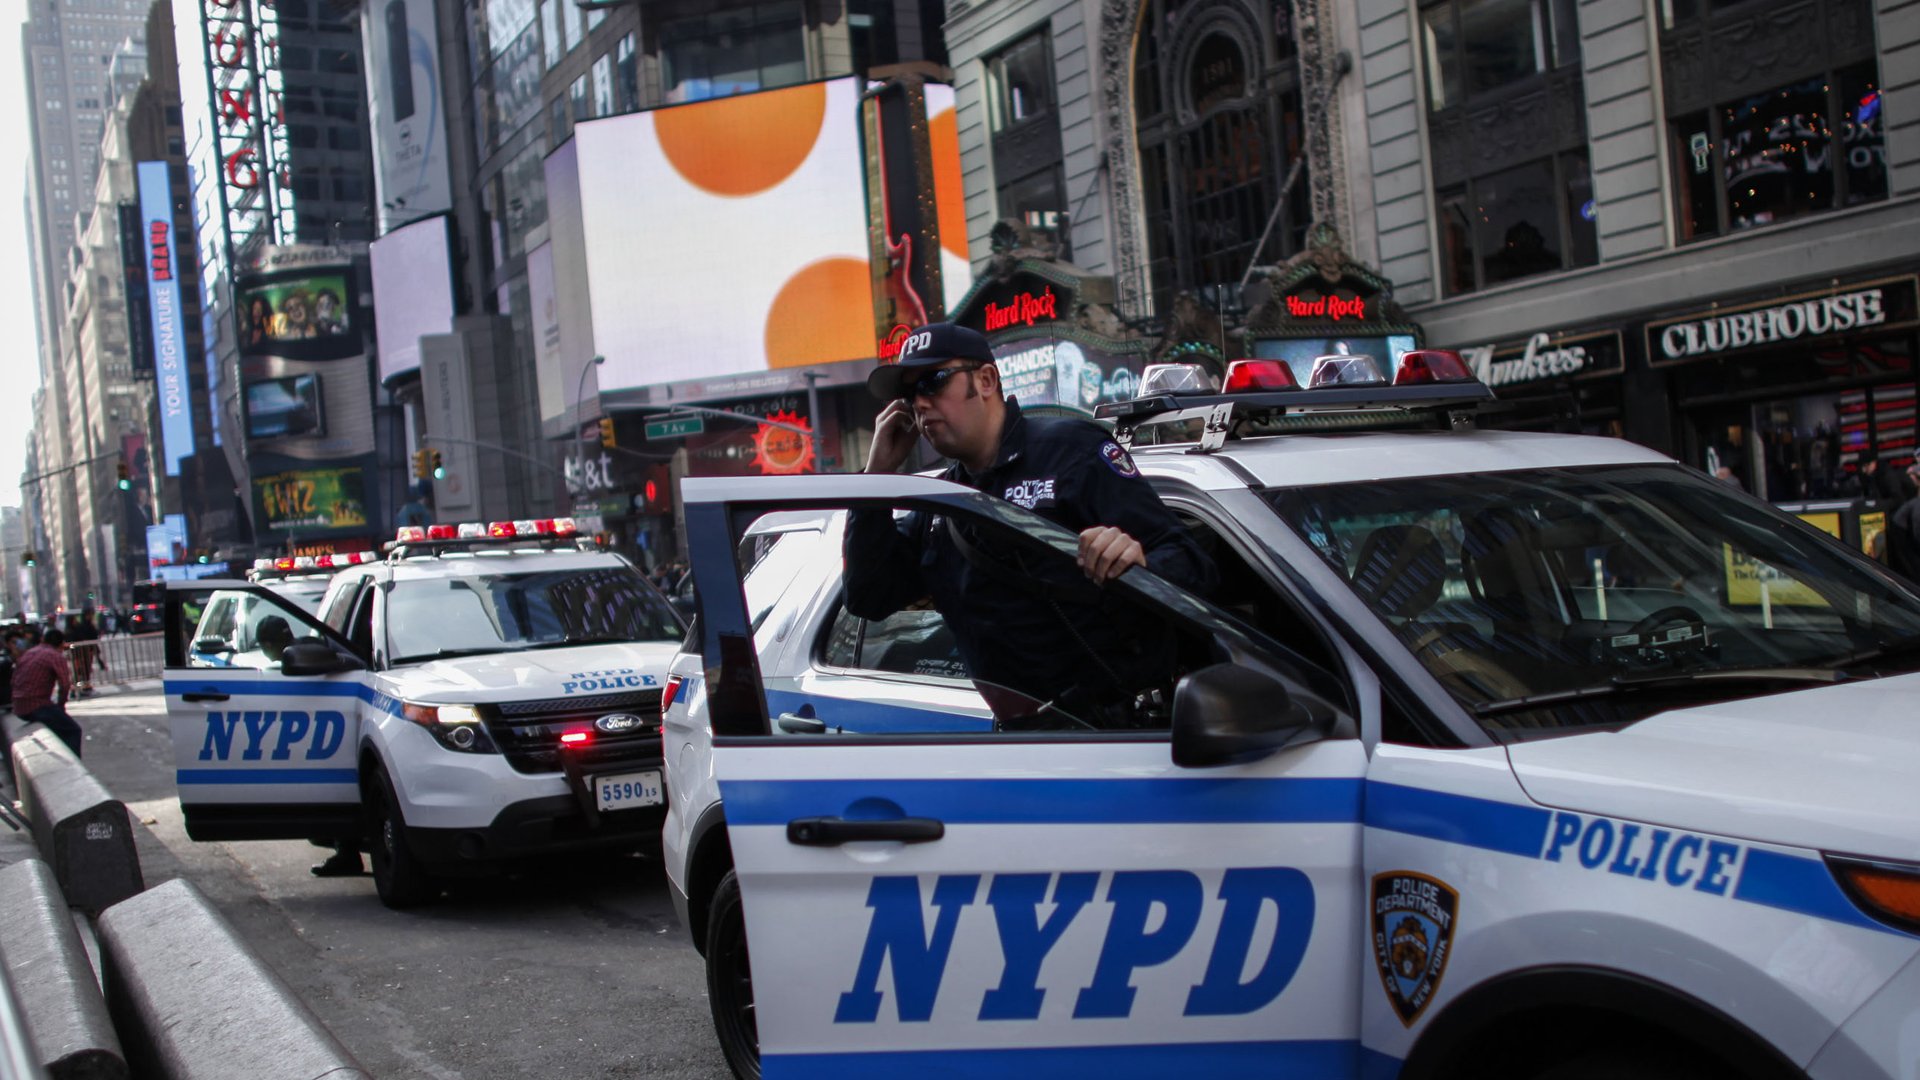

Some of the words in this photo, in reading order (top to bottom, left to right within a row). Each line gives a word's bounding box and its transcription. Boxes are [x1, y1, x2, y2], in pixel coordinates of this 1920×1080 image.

[151, 221, 173, 281] BRAND
[985, 294, 1019, 331] Hard
[1021, 285, 1057, 327] Rock
[1286, 295, 1327, 316] Hard
[1328, 295, 1365, 320] Rock
[1661, 289, 1886, 359] CLUBHOUSE
[156, 287, 178, 371] SIGNATURE
[898, 331, 932, 362] PD
[879, 338, 901, 359] Hard
[164, 374, 182, 417] YOUR
[661, 424, 668, 434] 7
[671, 424, 686, 434] Av
[1005, 479, 1055, 500] POLICE
[562, 674, 657, 694] POLICE
[570, 668, 634, 679] NYPD
[198, 711, 346, 761] NYPD
[606, 716, 633, 729] Ford
[602, 782, 643, 802] 5590
[645, 787, 657, 798] 15
[1545, 812, 1739, 897] POLICE
[1392, 878, 1440, 903] POLICE
[1376, 893, 1451, 930] DEPARTMENT
[833, 866, 1316, 1024] NYPD
[1376, 932, 1389, 968] CITY
[1412, 981, 1431, 1009] NEW
[1429, 939, 1448, 976] YORK
